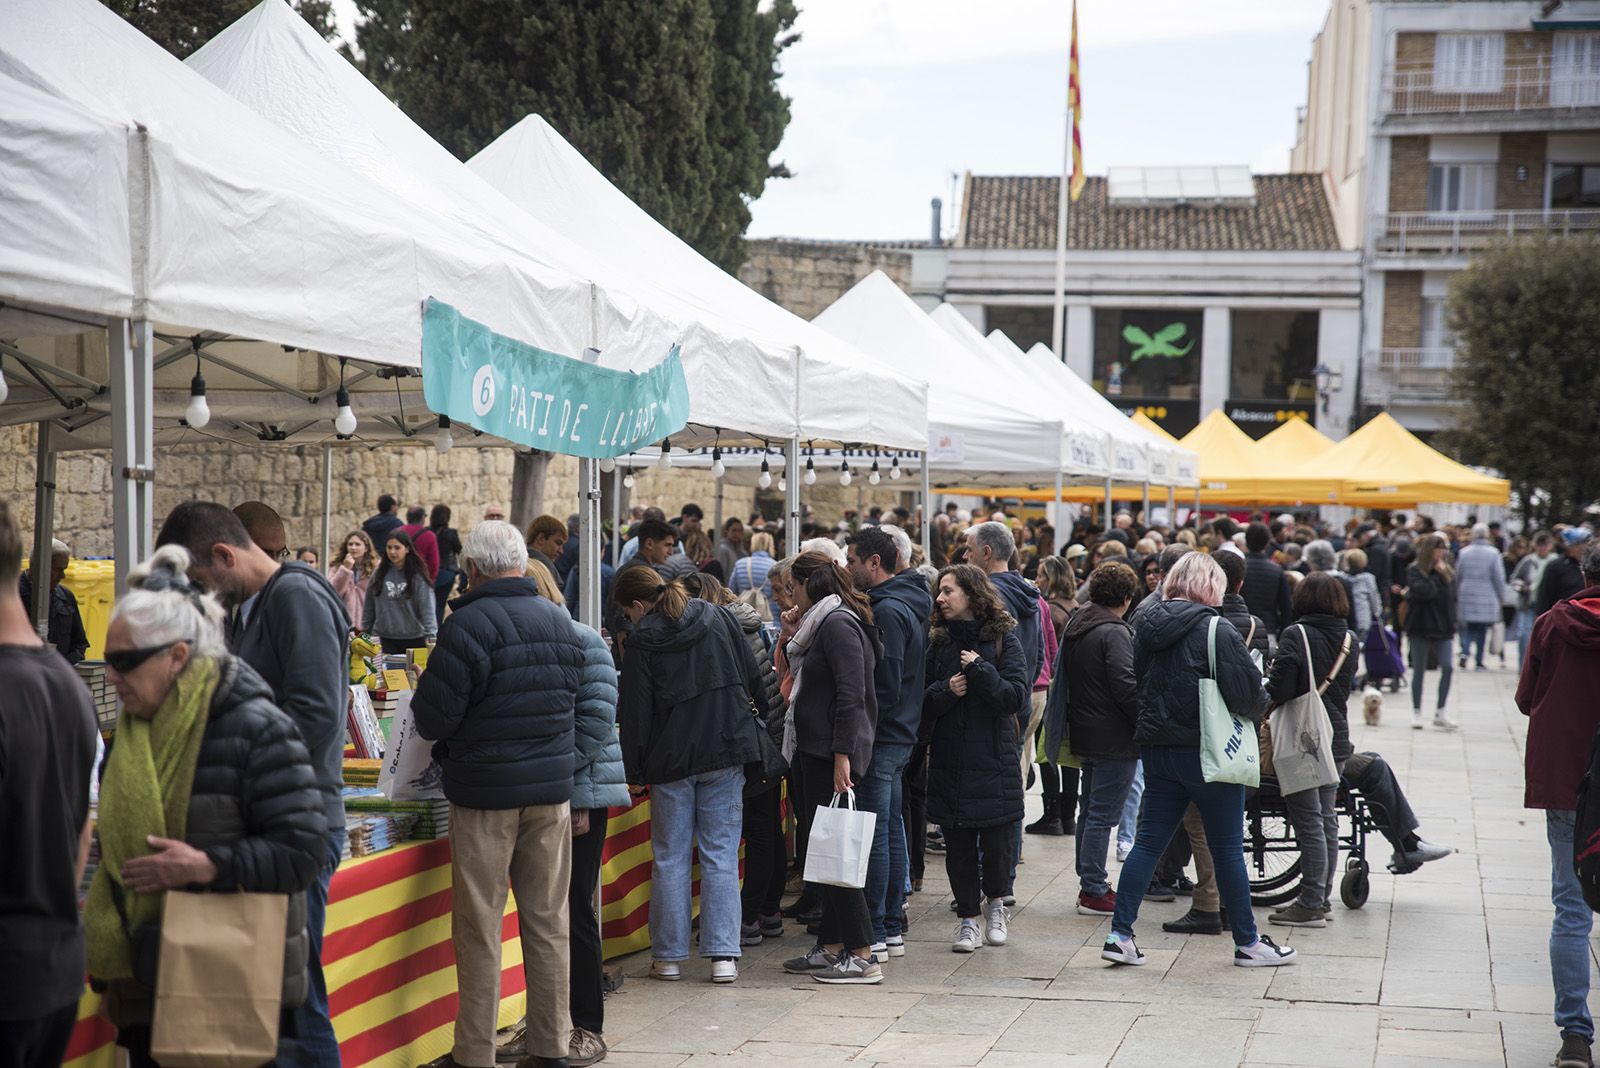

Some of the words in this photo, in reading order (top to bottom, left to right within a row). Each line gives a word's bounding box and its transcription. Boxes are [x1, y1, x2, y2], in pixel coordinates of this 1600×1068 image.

[481, 376, 490, 405] 6
[508, 384, 555, 436] PATI
[559, 399, 589, 441] DE
[599, 400, 661, 447] LLIBRE
